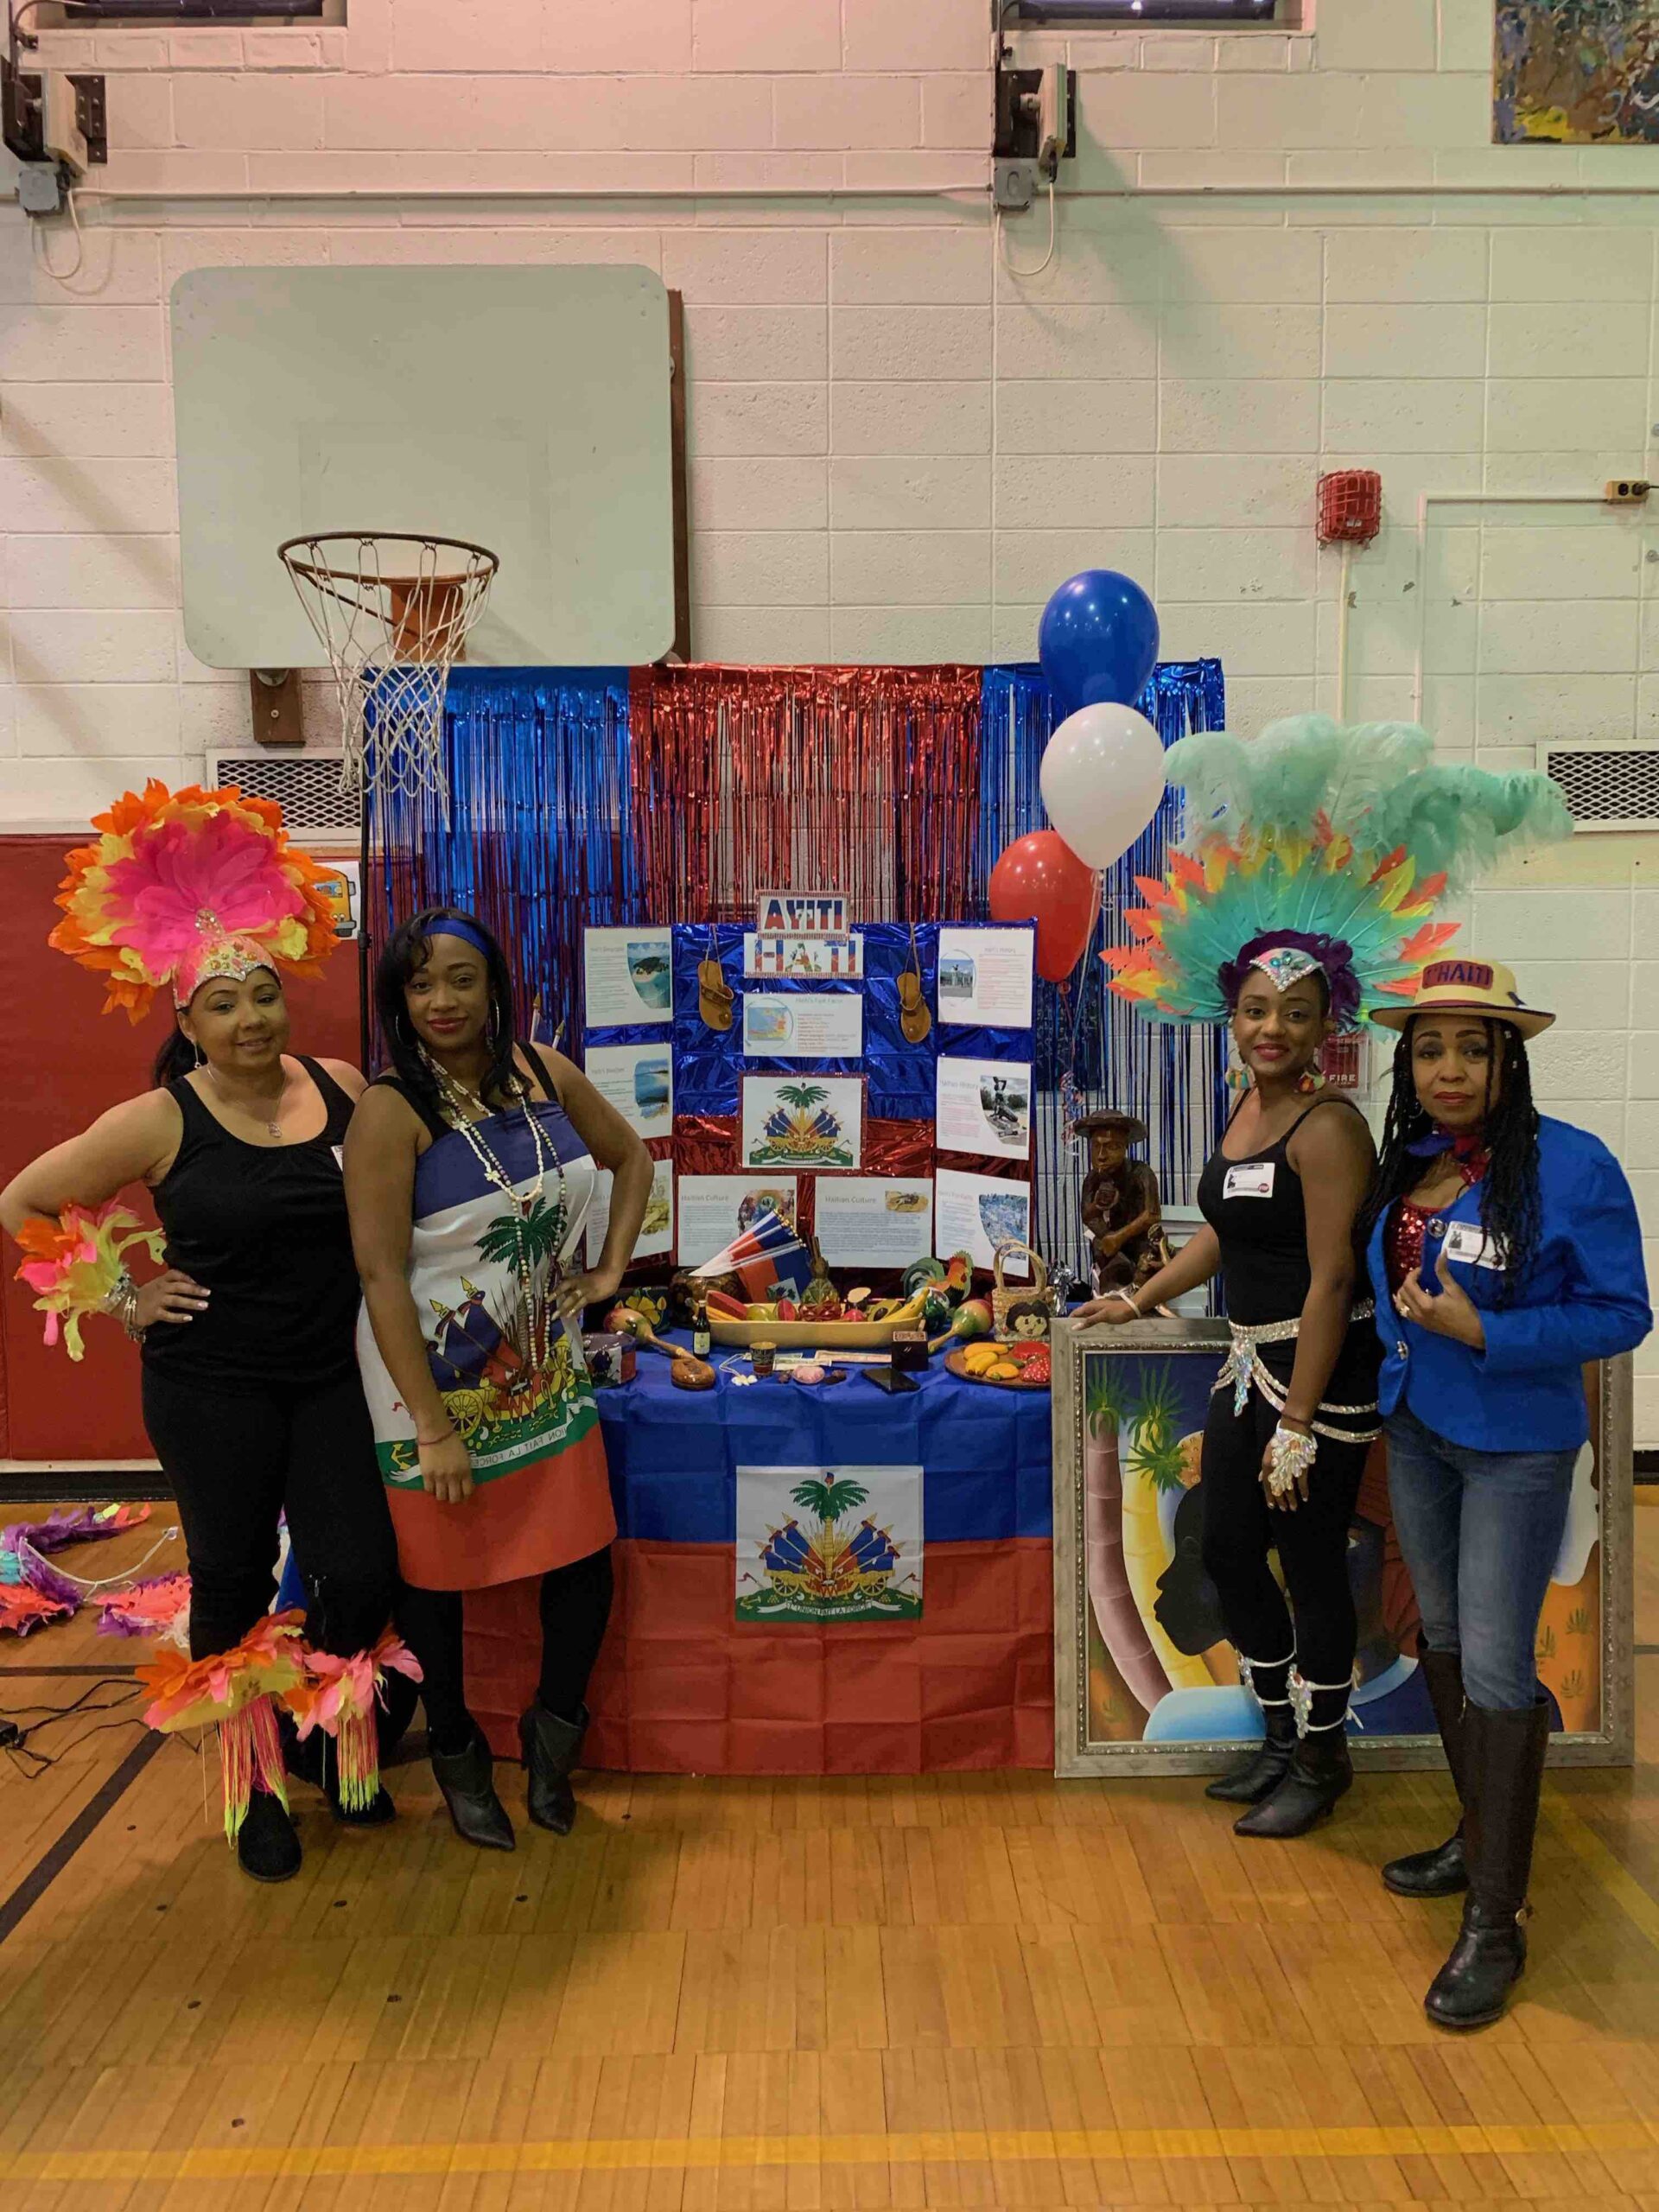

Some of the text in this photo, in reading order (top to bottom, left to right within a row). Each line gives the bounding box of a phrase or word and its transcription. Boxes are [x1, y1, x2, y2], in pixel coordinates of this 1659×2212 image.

[764, 899, 842, 930] AYITI
[754, 939, 856, 972] HAITI
[825, 1195, 849, 1204] Haitian
